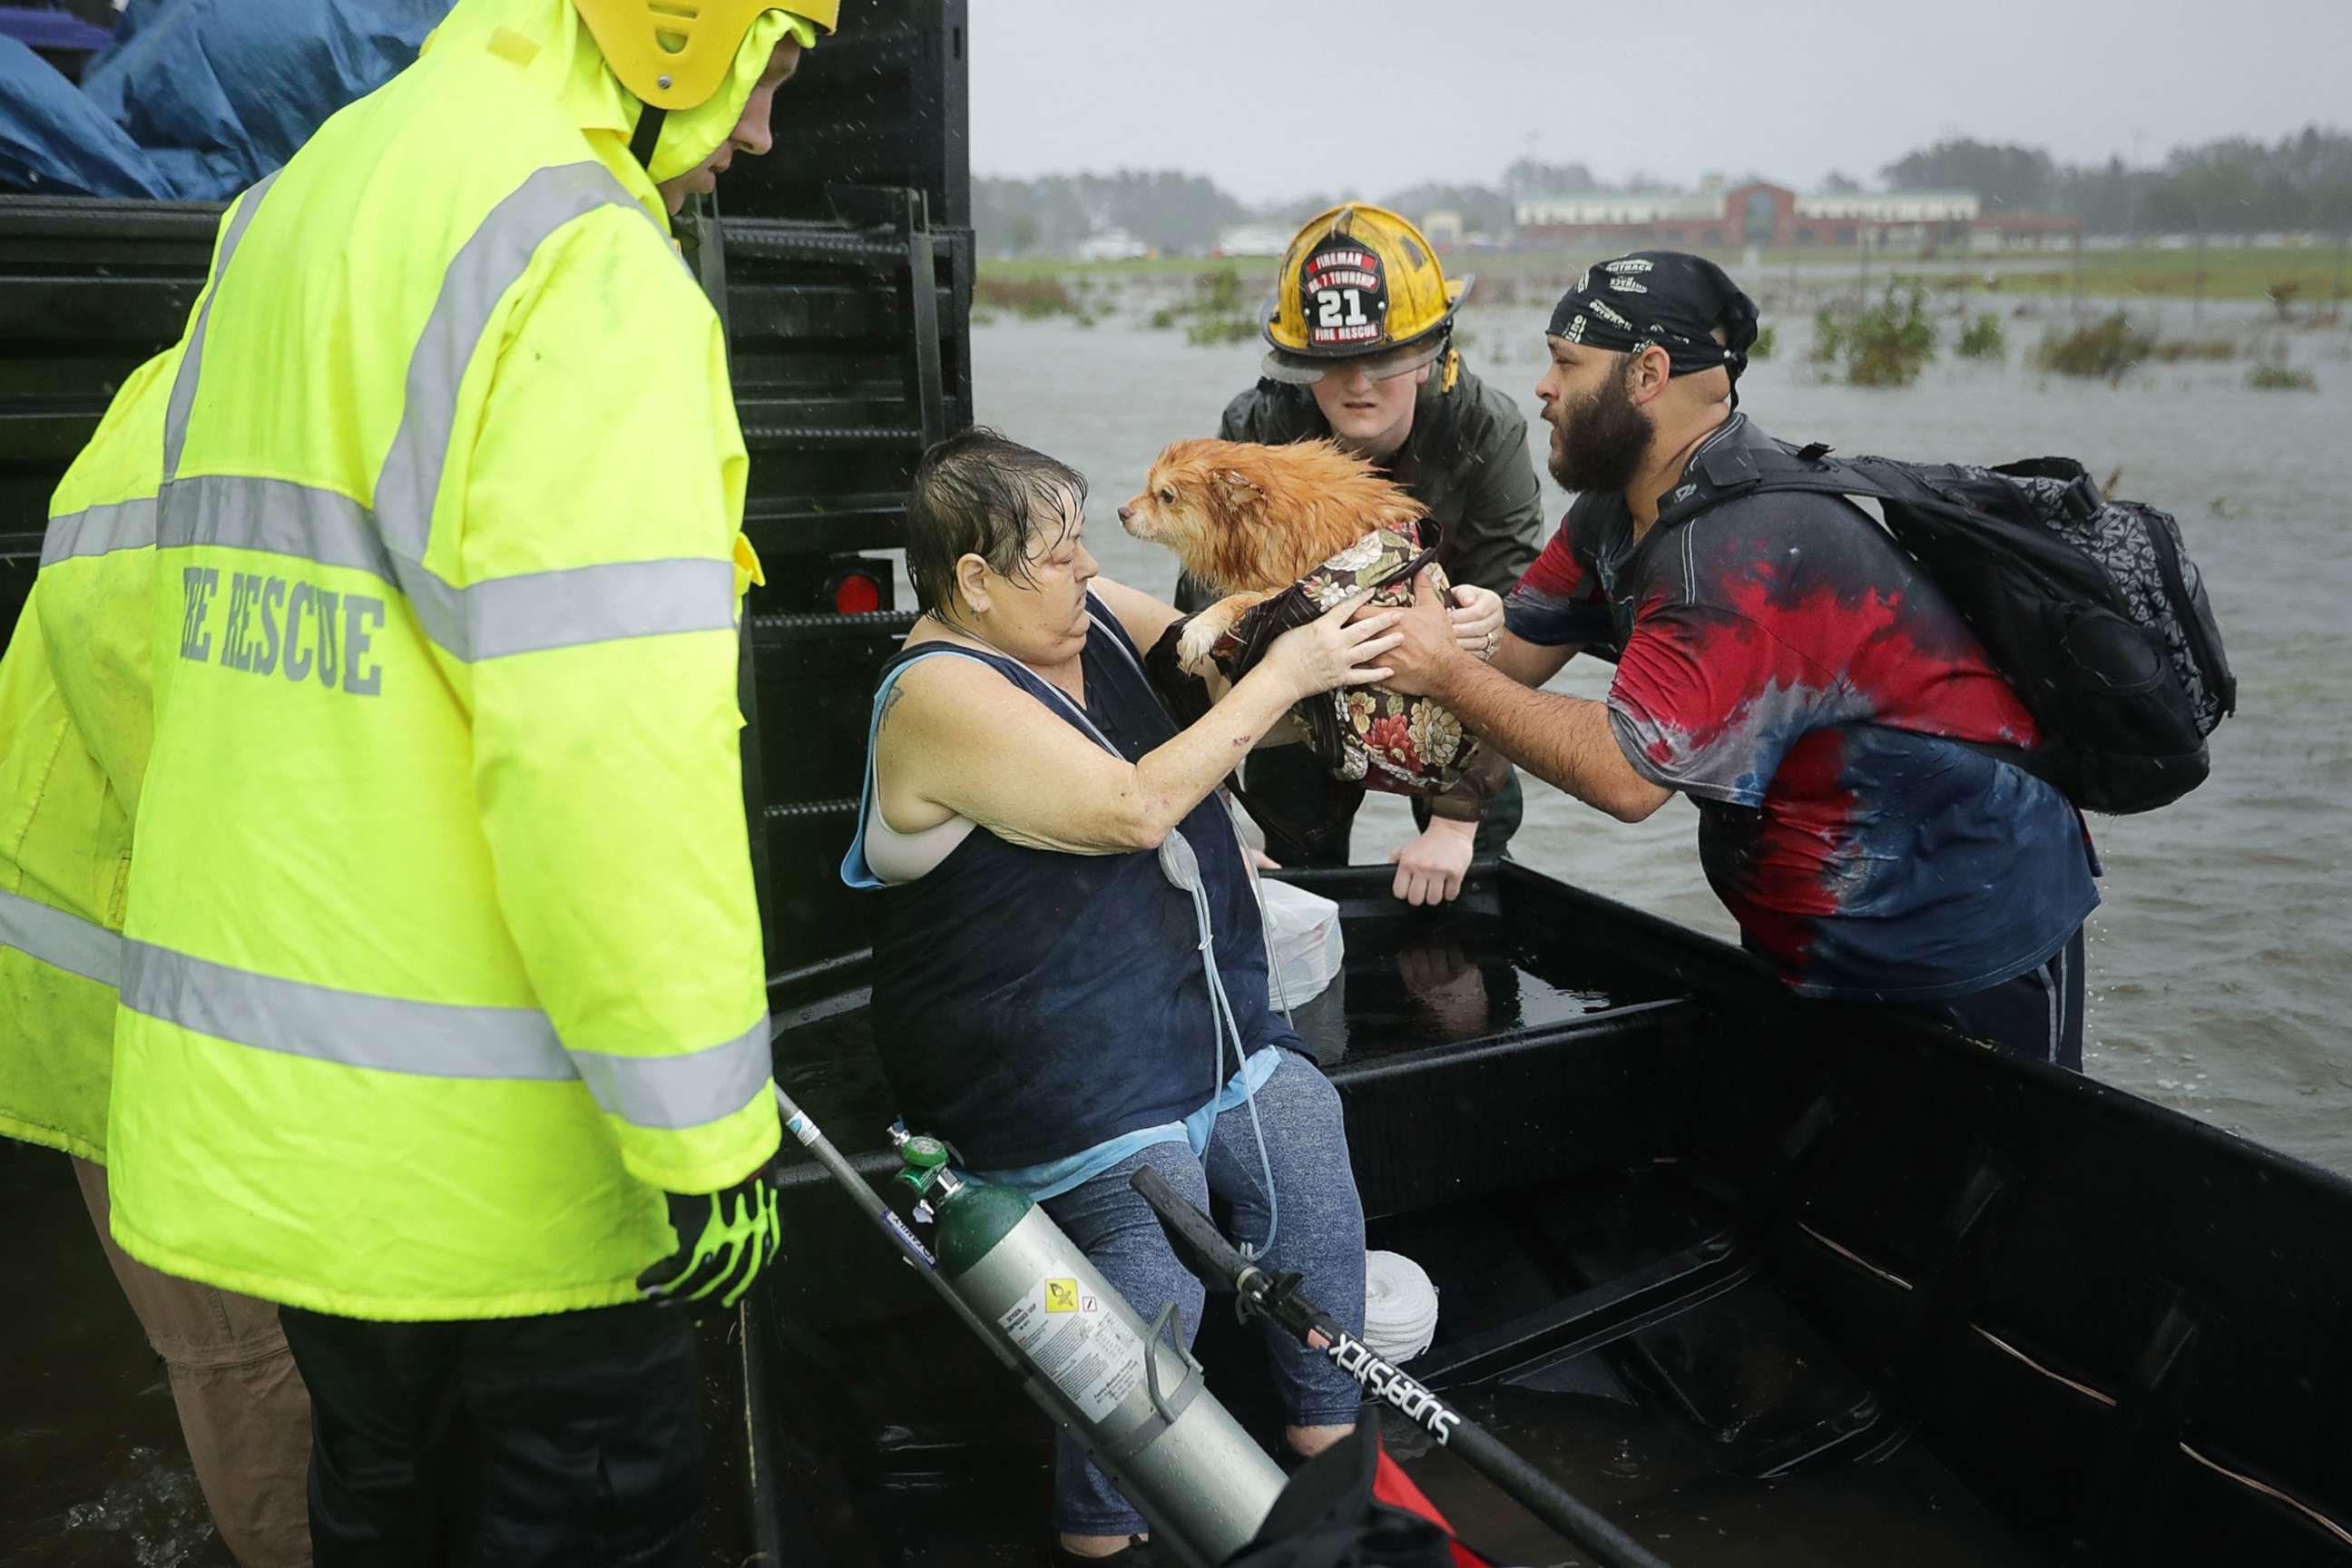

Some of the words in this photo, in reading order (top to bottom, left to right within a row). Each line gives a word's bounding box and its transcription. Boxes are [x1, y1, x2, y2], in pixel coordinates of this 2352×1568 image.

[1316, 251, 1363, 270] FIREMAN
[1328, 270, 1377, 289] TOWNSHIP
[1317, 289, 1367, 328] 21
[1315, 327, 1337, 341] FIRE
[1338, 323, 1377, 340] RESCUE
[220, 573, 385, 696] RESCUE
